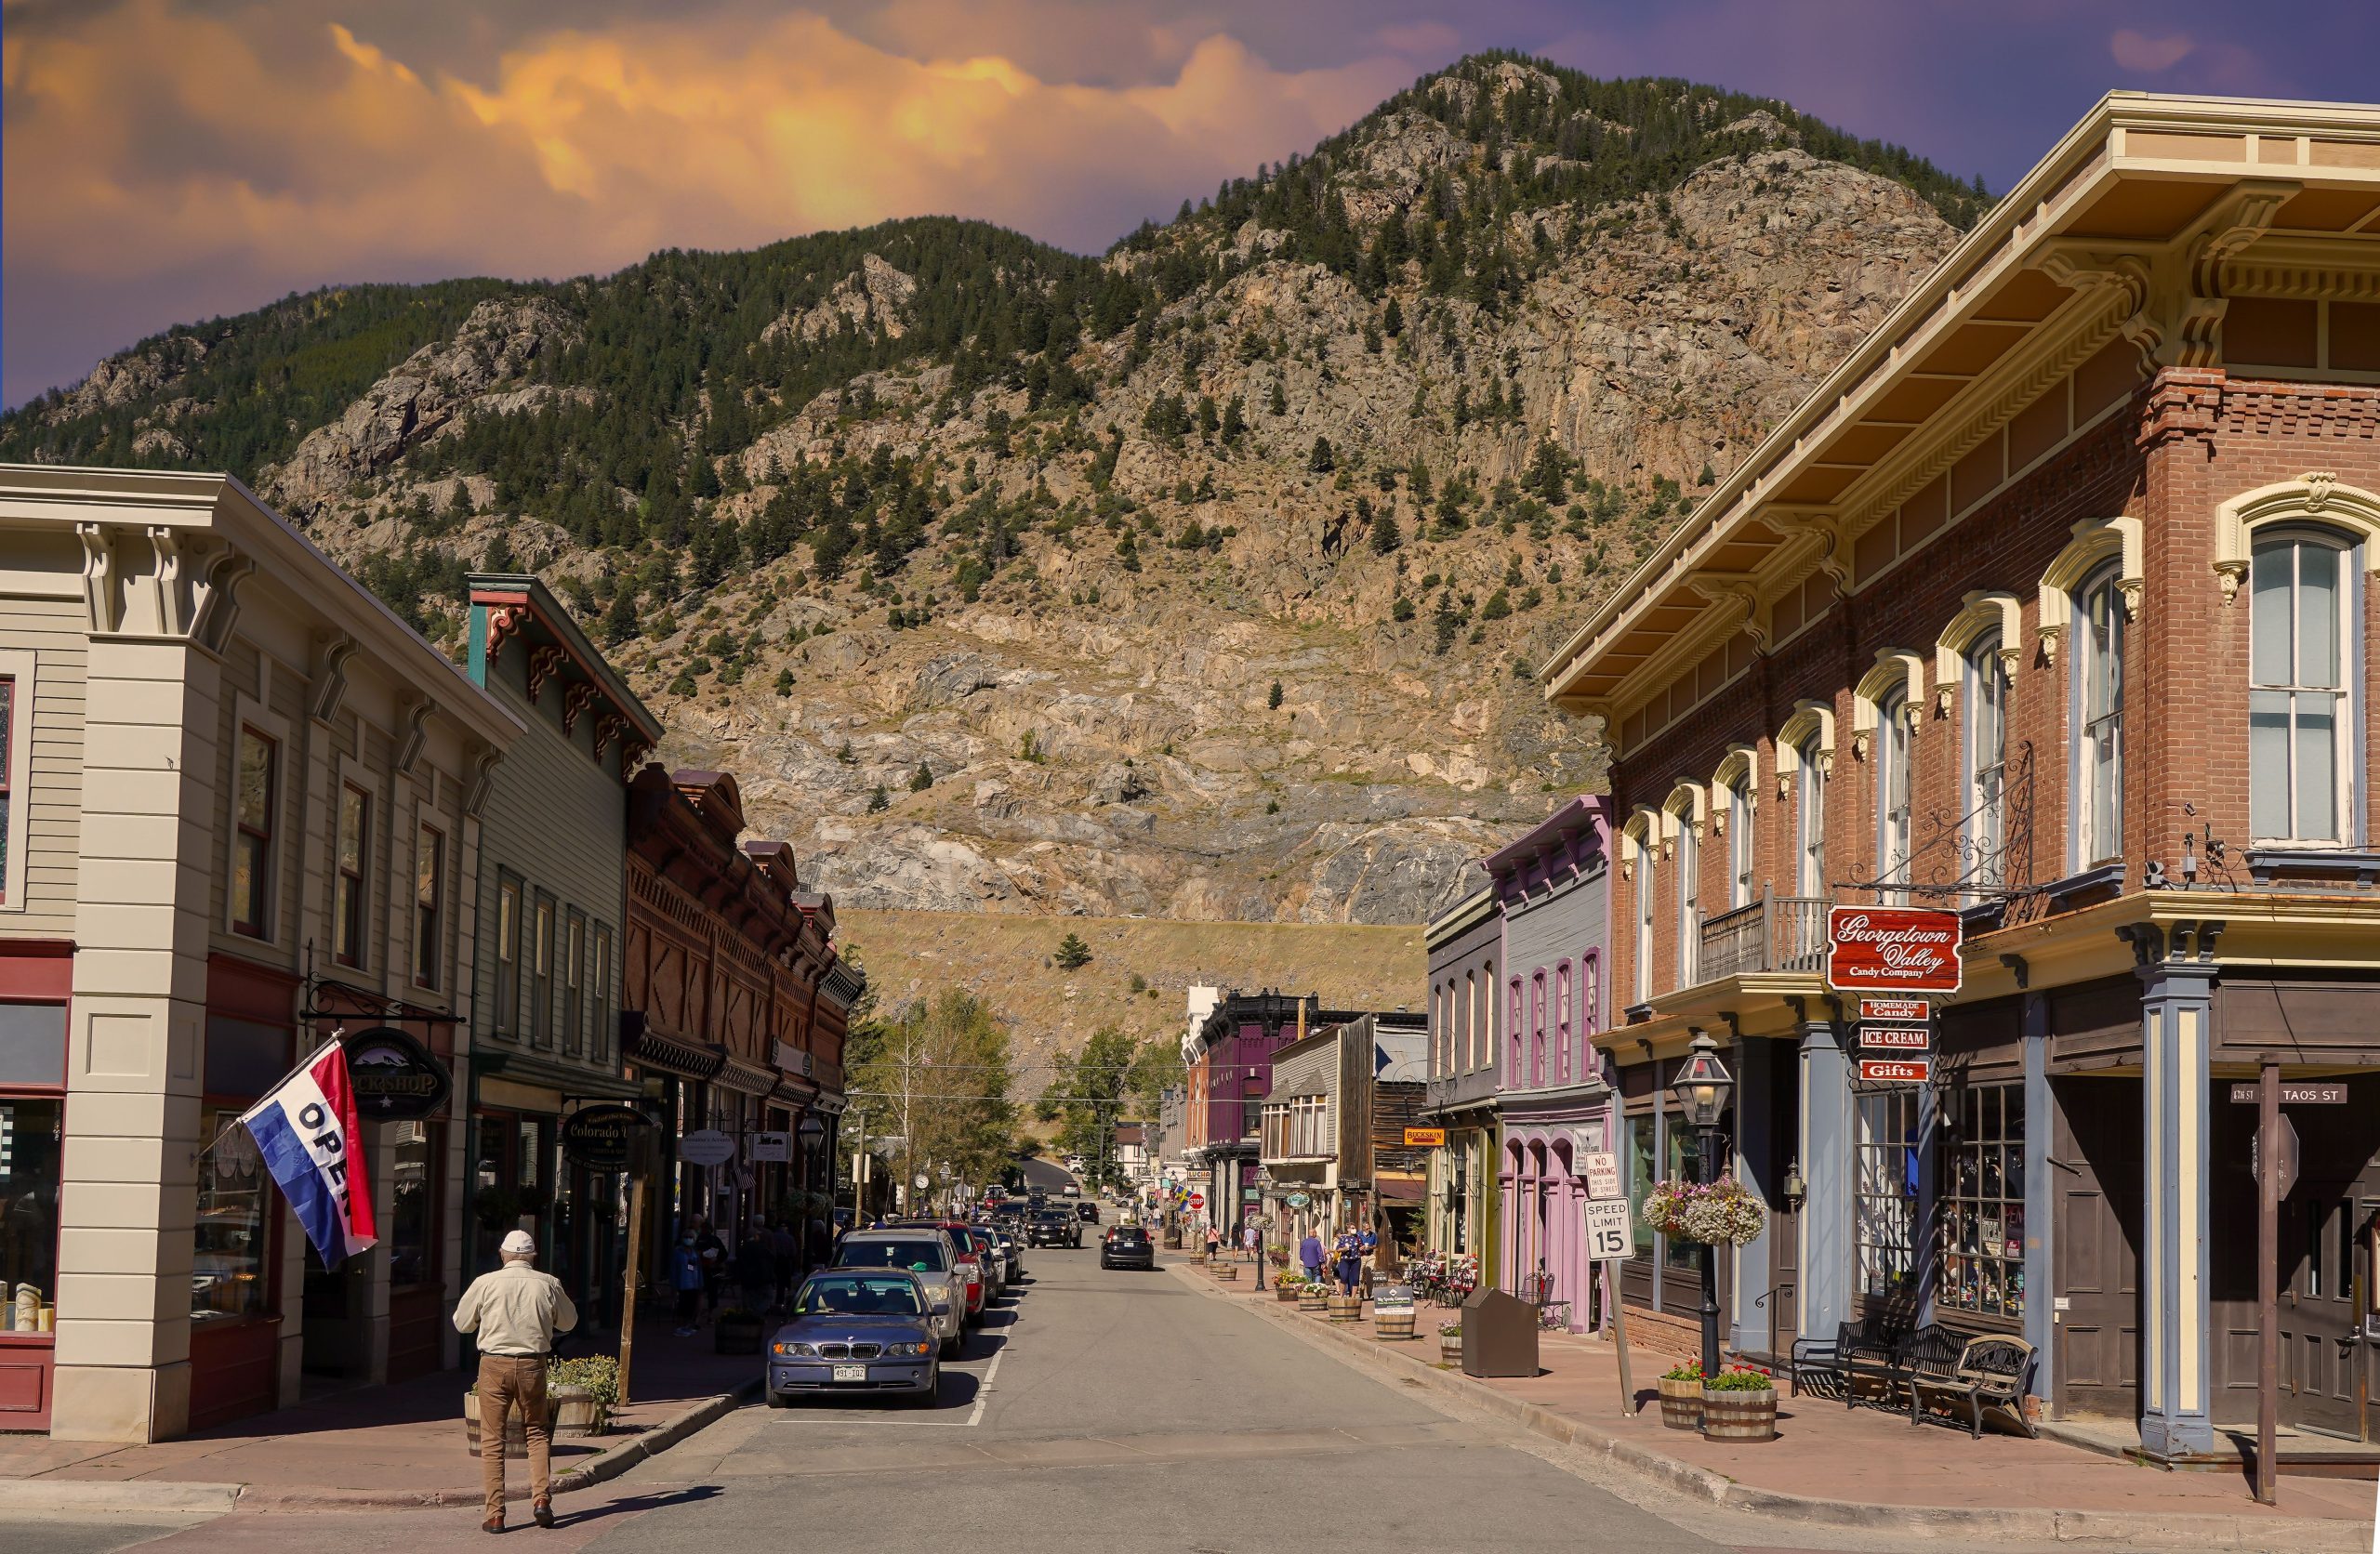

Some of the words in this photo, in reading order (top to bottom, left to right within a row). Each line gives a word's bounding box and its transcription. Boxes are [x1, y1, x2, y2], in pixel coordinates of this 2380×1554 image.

[1837, 915, 1950, 952] Georgetown
[1884, 944, 1944, 974] Valley
[1849, 967, 1880, 978] Candy
[1881, 968, 1924, 978] Company
[1873, 1008, 1915, 1018] Candy
[1865, 1032, 1882, 1043] ICE
[1885, 1032, 1924, 1044] CREAM
[1869, 1065, 1913, 1076] Gifts
[386, 1076, 434, 1092] SHOP
[2283, 1090, 2317, 1100] TAOS
[2322, 1090, 2338, 1100] ST
[570, 1124, 619, 1139] Colorado
[1407, 1131, 1442, 1139] BUCKSKIN
[1595, 1157, 1606, 1166] NO
[1590, 1166, 1616, 1178] PARKING
[1600, 1185, 1617, 1193] STREET
[1588, 1205, 1626, 1215] SPEED
[1593, 1218, 1622, 1227] LIMIT
[1596, 1231, 1623, 1252] 15
